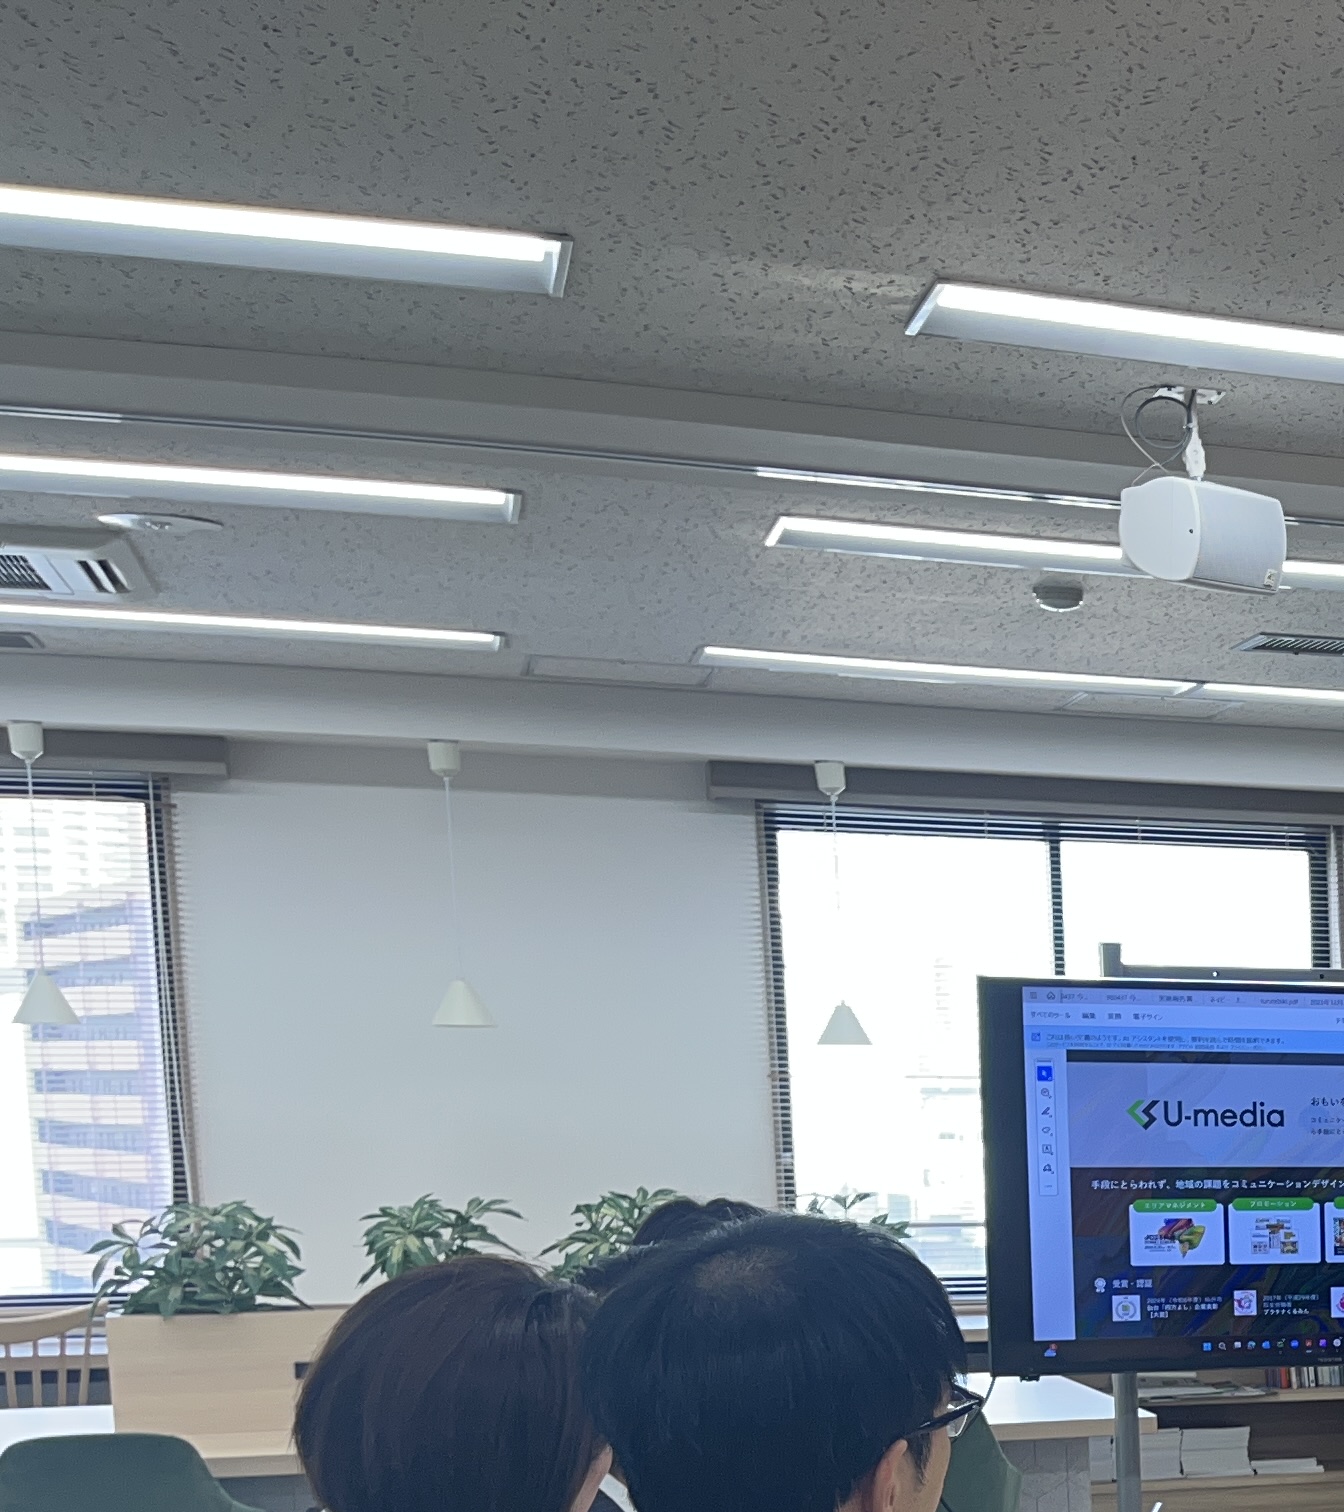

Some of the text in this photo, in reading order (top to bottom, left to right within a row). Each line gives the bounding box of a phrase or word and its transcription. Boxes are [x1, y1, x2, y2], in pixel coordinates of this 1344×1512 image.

[1163, 1100, 1285, 1128] U-media
[1250, 1200, 1297, 1208] プロモーション
